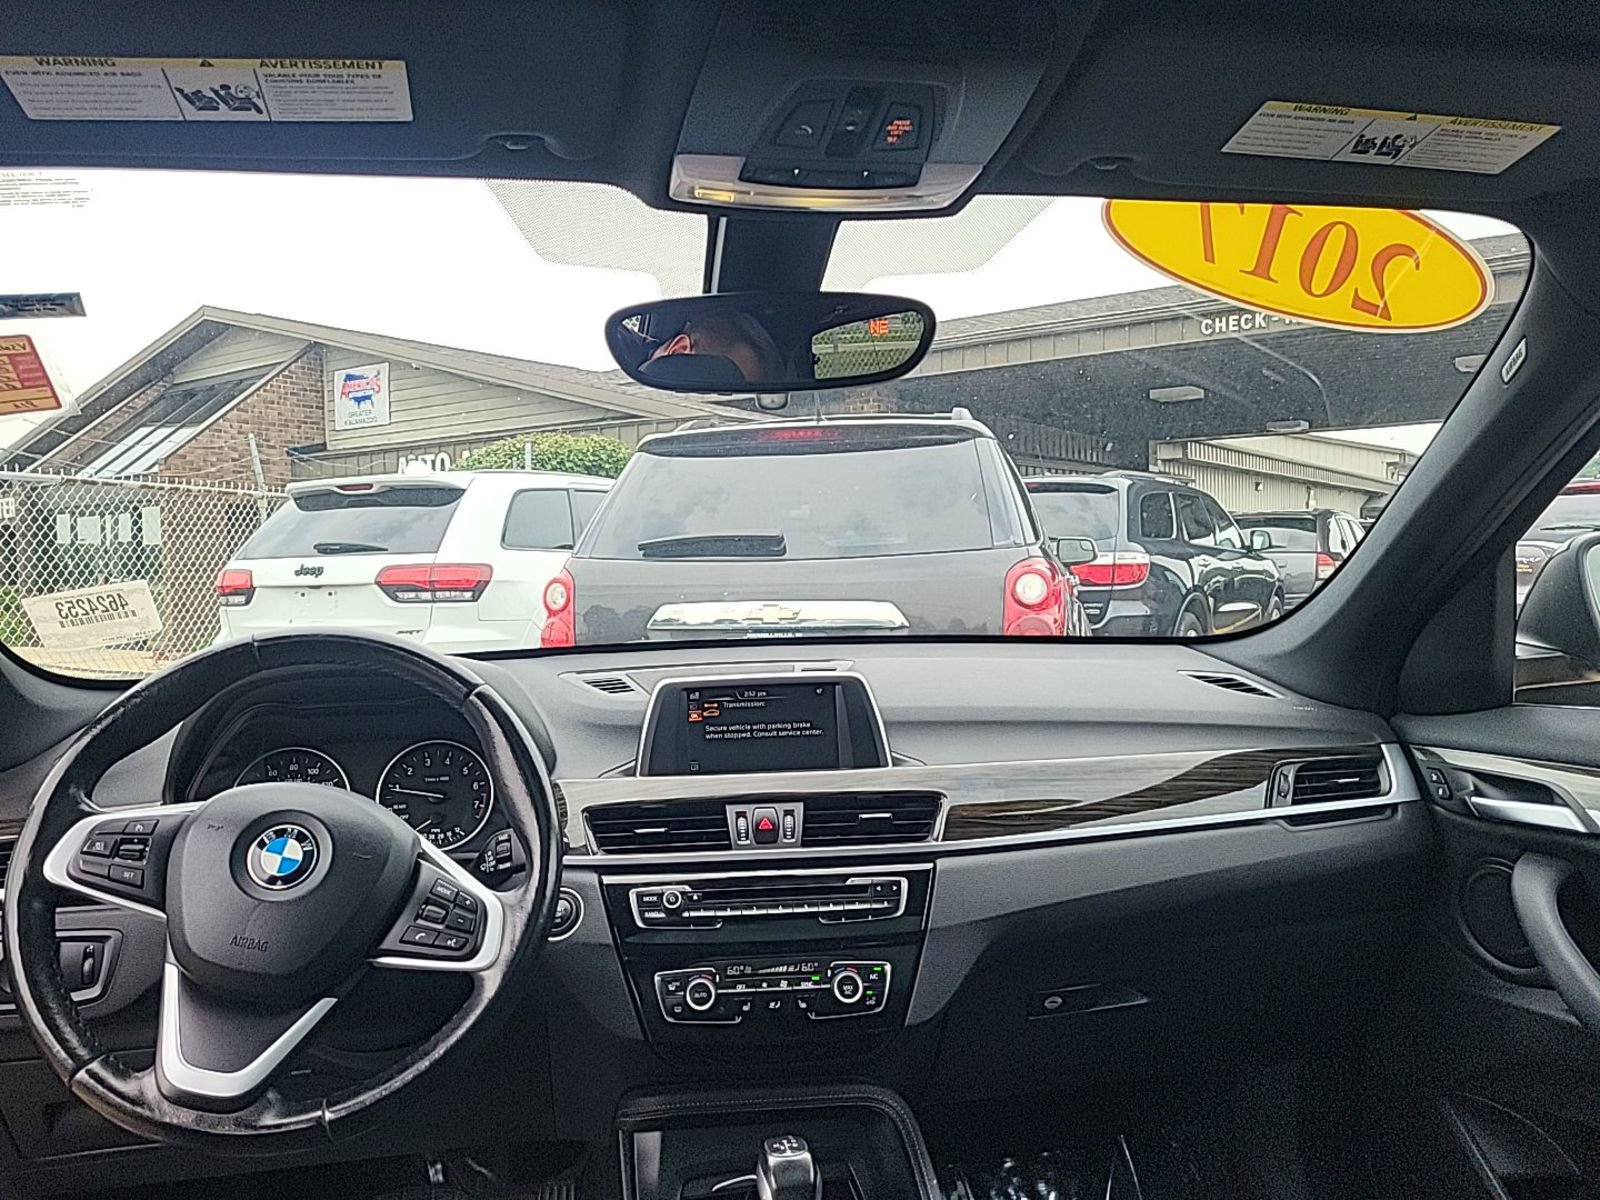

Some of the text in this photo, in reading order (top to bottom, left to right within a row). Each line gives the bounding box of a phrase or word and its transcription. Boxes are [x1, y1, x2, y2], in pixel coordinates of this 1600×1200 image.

[34, 57, 116, 67] WARNING
[259, 59, 385, 70] AVERTISSEMENT
[1293, 105, 1350, 116] WARNING
[1449, 117, 1545, 132] AVERTISSEMENT
[870, 319, 889, 335] NE
[294, 563, 324, 578] Jeep
[722, 701, 766, 709] Transmission:
[705, 721, 811, 732] Secure vehicle with parking brake
[724, 732, 751, 740] stopped.
[753, 730, 777, 738] Consult
[802, 728, 825, 736] center.
[289, 763, 299, 771] 80
[425, 758, 432, 767] 3
[407, 767, 414, 775] 2
[473, 781, 479, 790] 6
[474, 800, 480, 809] 7
[262, 827, 314, 852] BMW
[230, 934, 269, 953] AIRBAG
